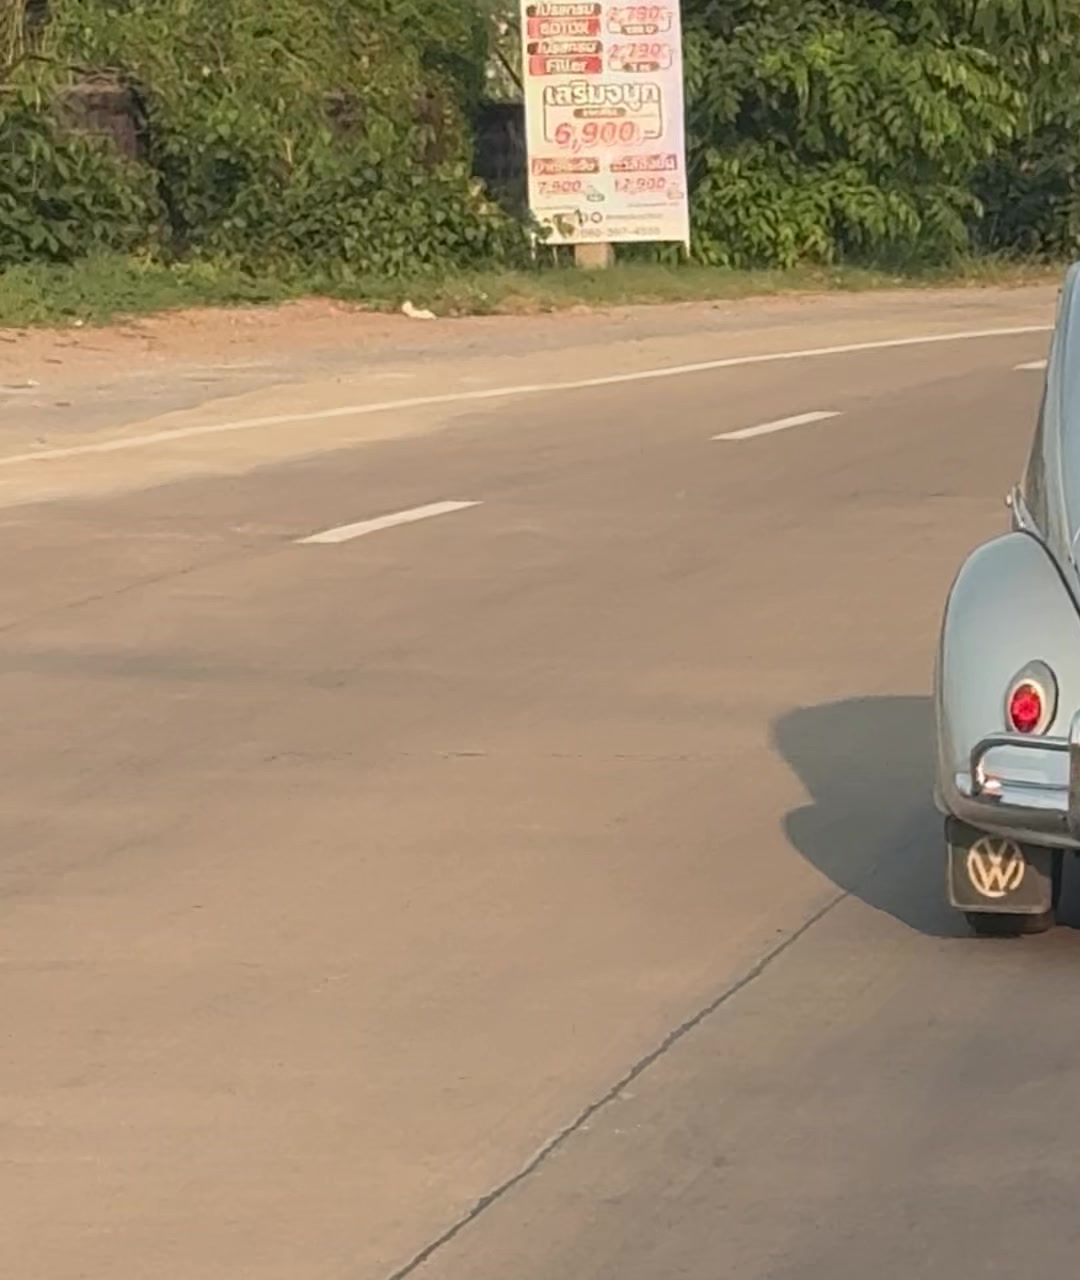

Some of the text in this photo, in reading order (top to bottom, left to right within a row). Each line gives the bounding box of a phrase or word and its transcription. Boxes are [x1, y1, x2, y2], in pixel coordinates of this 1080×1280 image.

[545, 81, 659, 111] เสริมจมูก
[968, 836, 1025, 898] VW
